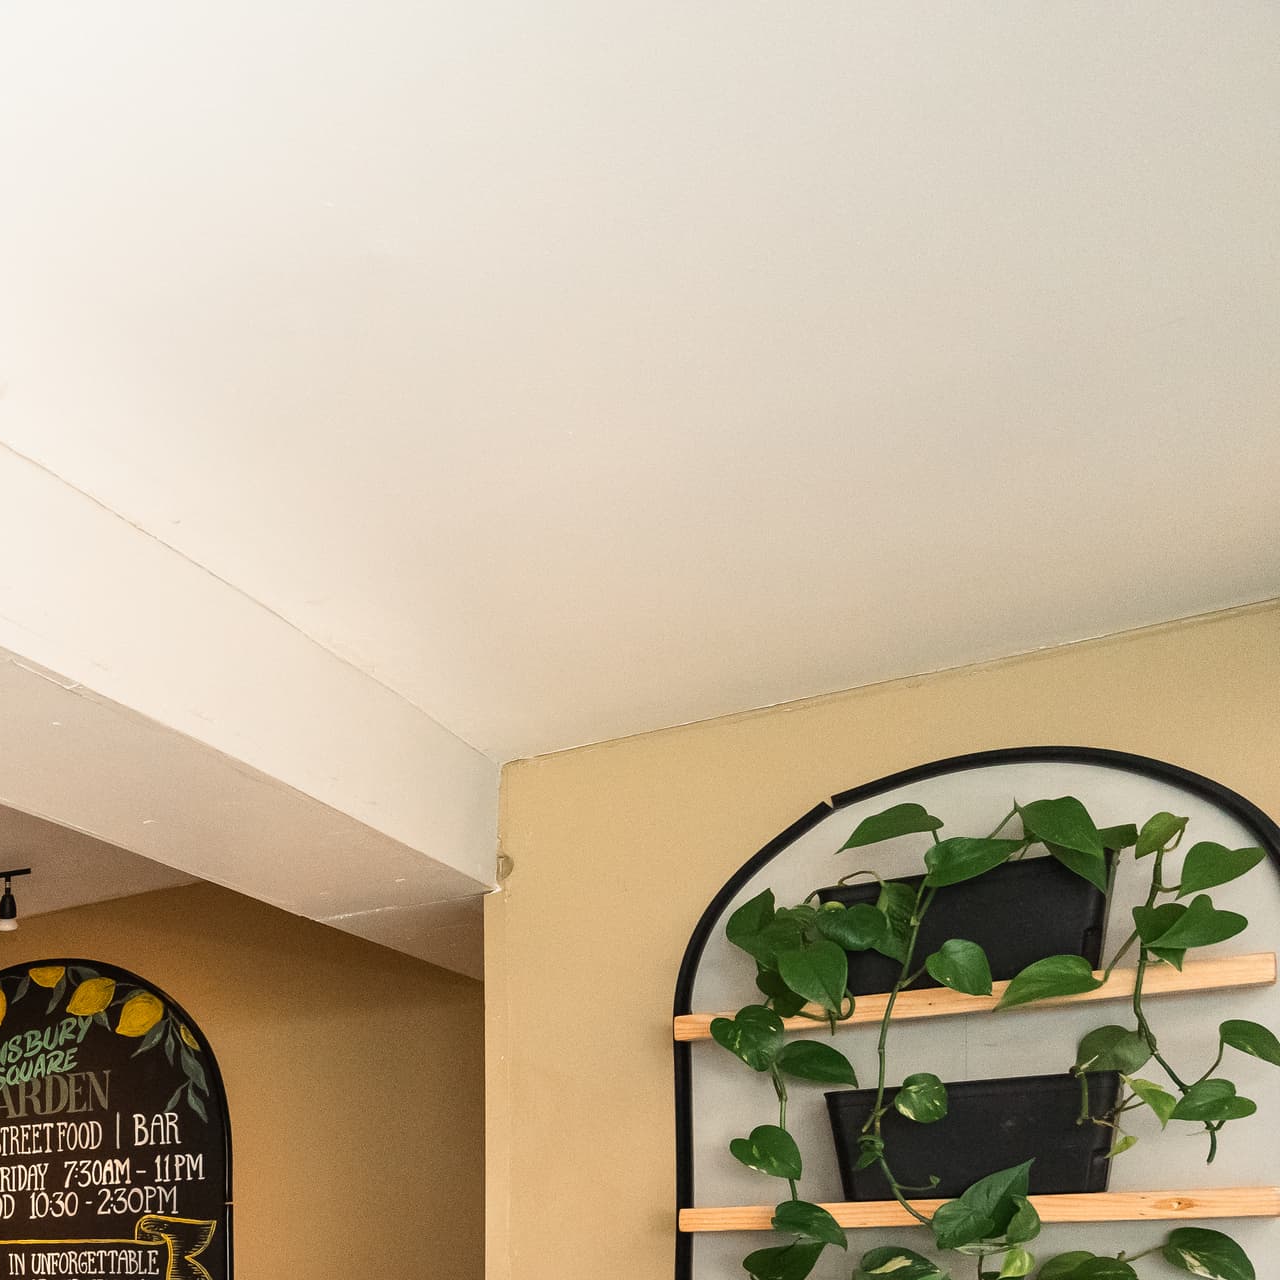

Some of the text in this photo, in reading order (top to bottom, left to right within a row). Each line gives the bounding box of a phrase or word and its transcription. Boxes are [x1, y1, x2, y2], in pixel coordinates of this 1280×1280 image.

[132, 1112, 183, 1147] BAR
[64, 1157, 132, 1189] 7:30AM
[153, 1153, 206, 1184] 11PM
[29, 1191, 79, 1220] 10:30
[96, 1185, 180, 1216] 2:30PM
[8, 1252, 26, 1275] IN
[31, 1250, 160, 1276] UNFORGETTABLE
